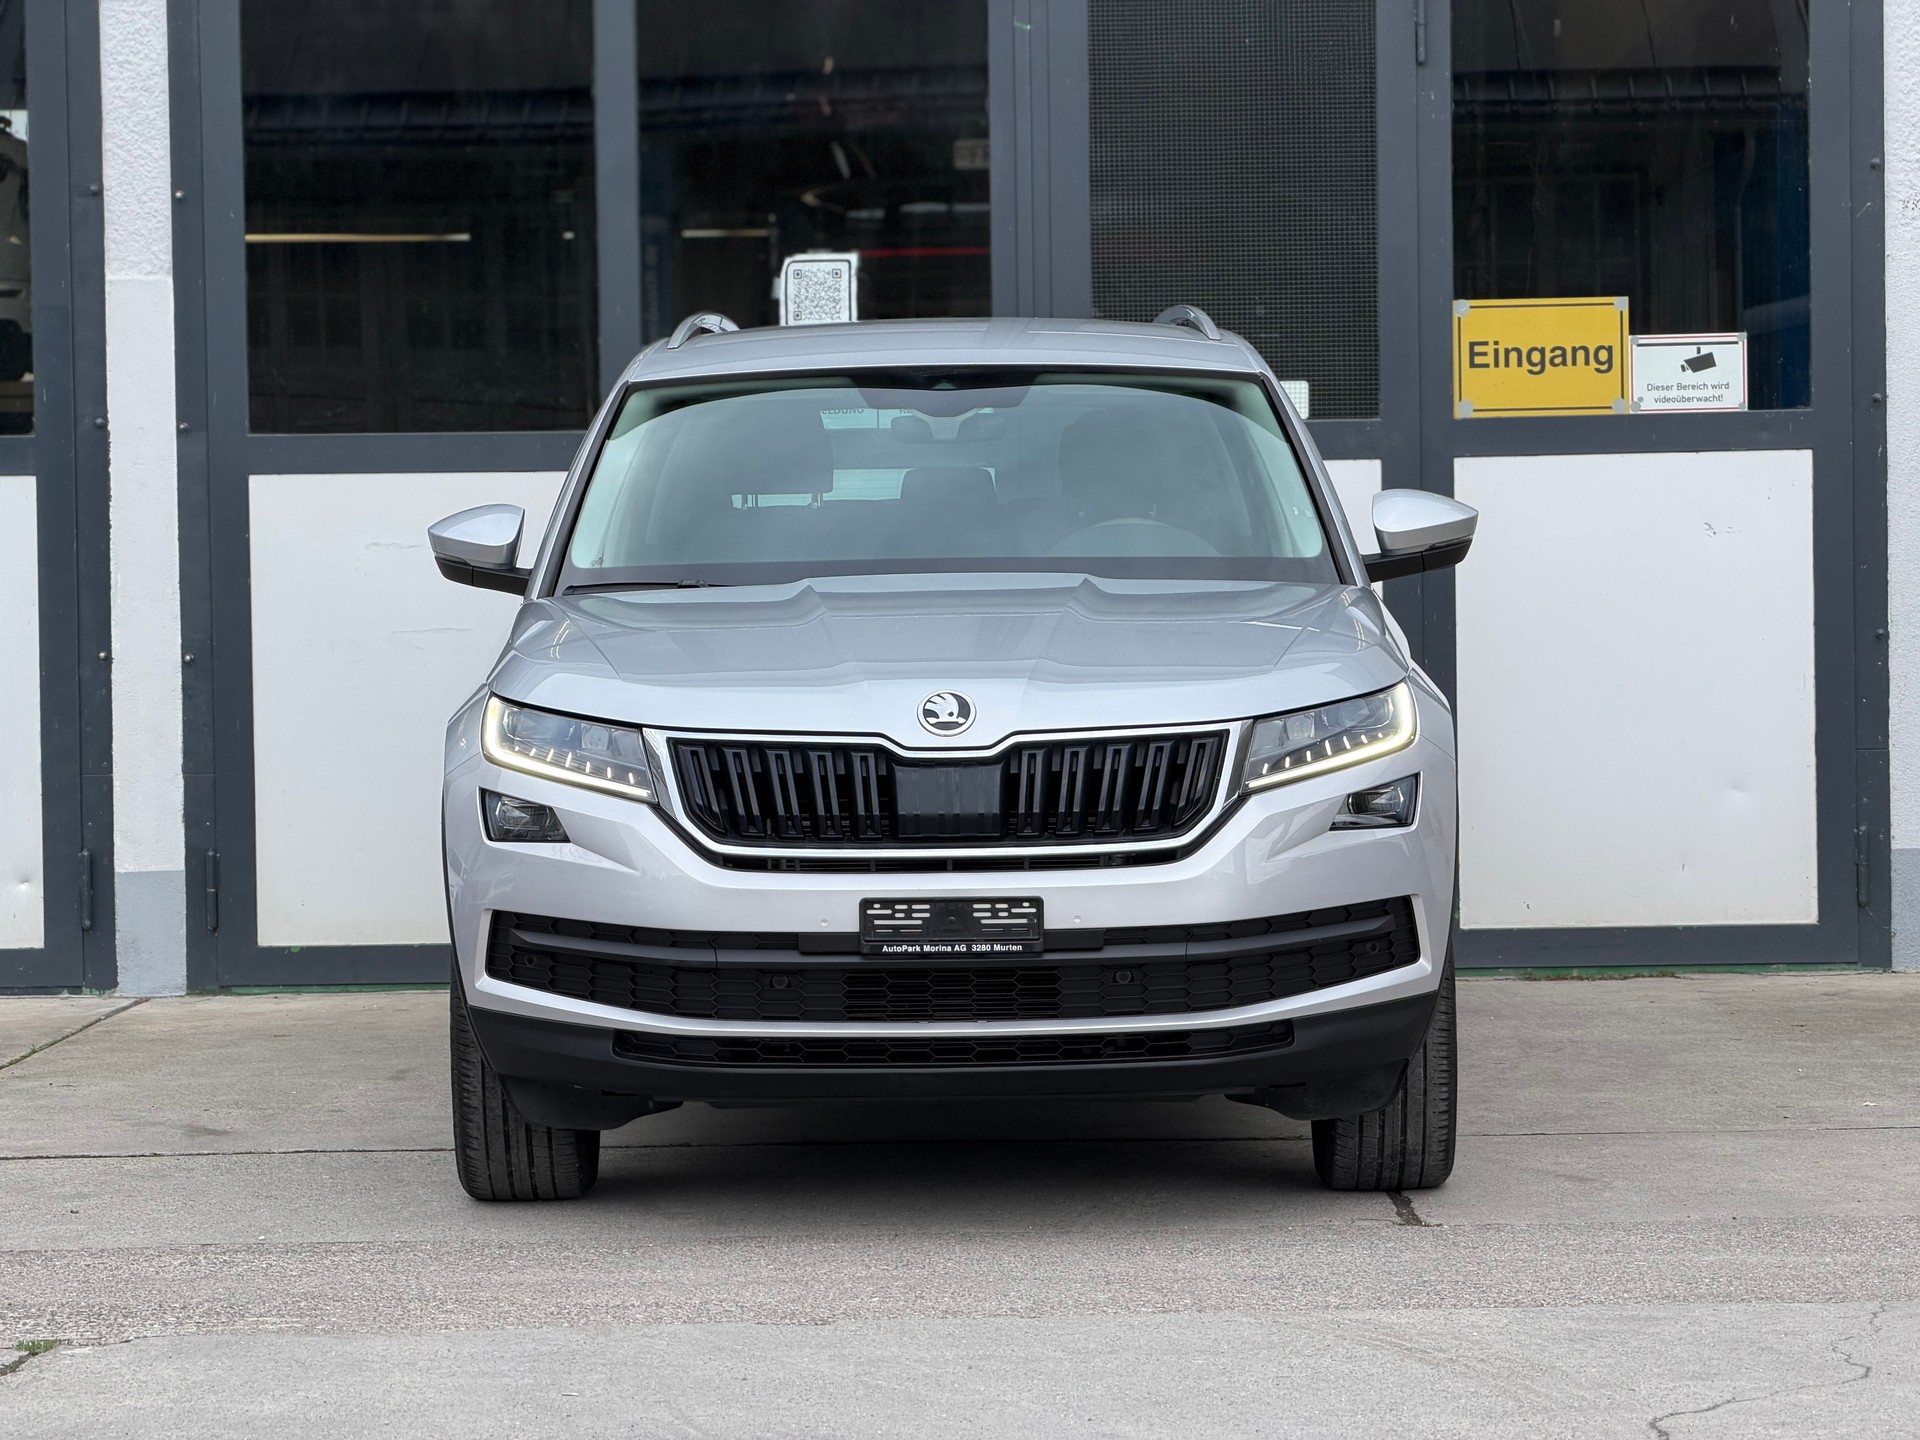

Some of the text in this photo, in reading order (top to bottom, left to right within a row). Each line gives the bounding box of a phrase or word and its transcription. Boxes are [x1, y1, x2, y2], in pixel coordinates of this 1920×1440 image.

[1468, 340, 1614, 376] Eingang
[1646, 381, 1730, 392] Dieser Bereich wird
[1653, 393, 1724, 404] videoüberwacht!
[882, 943, 1023, 953] AutoPark Morina AG 3280 Murten
